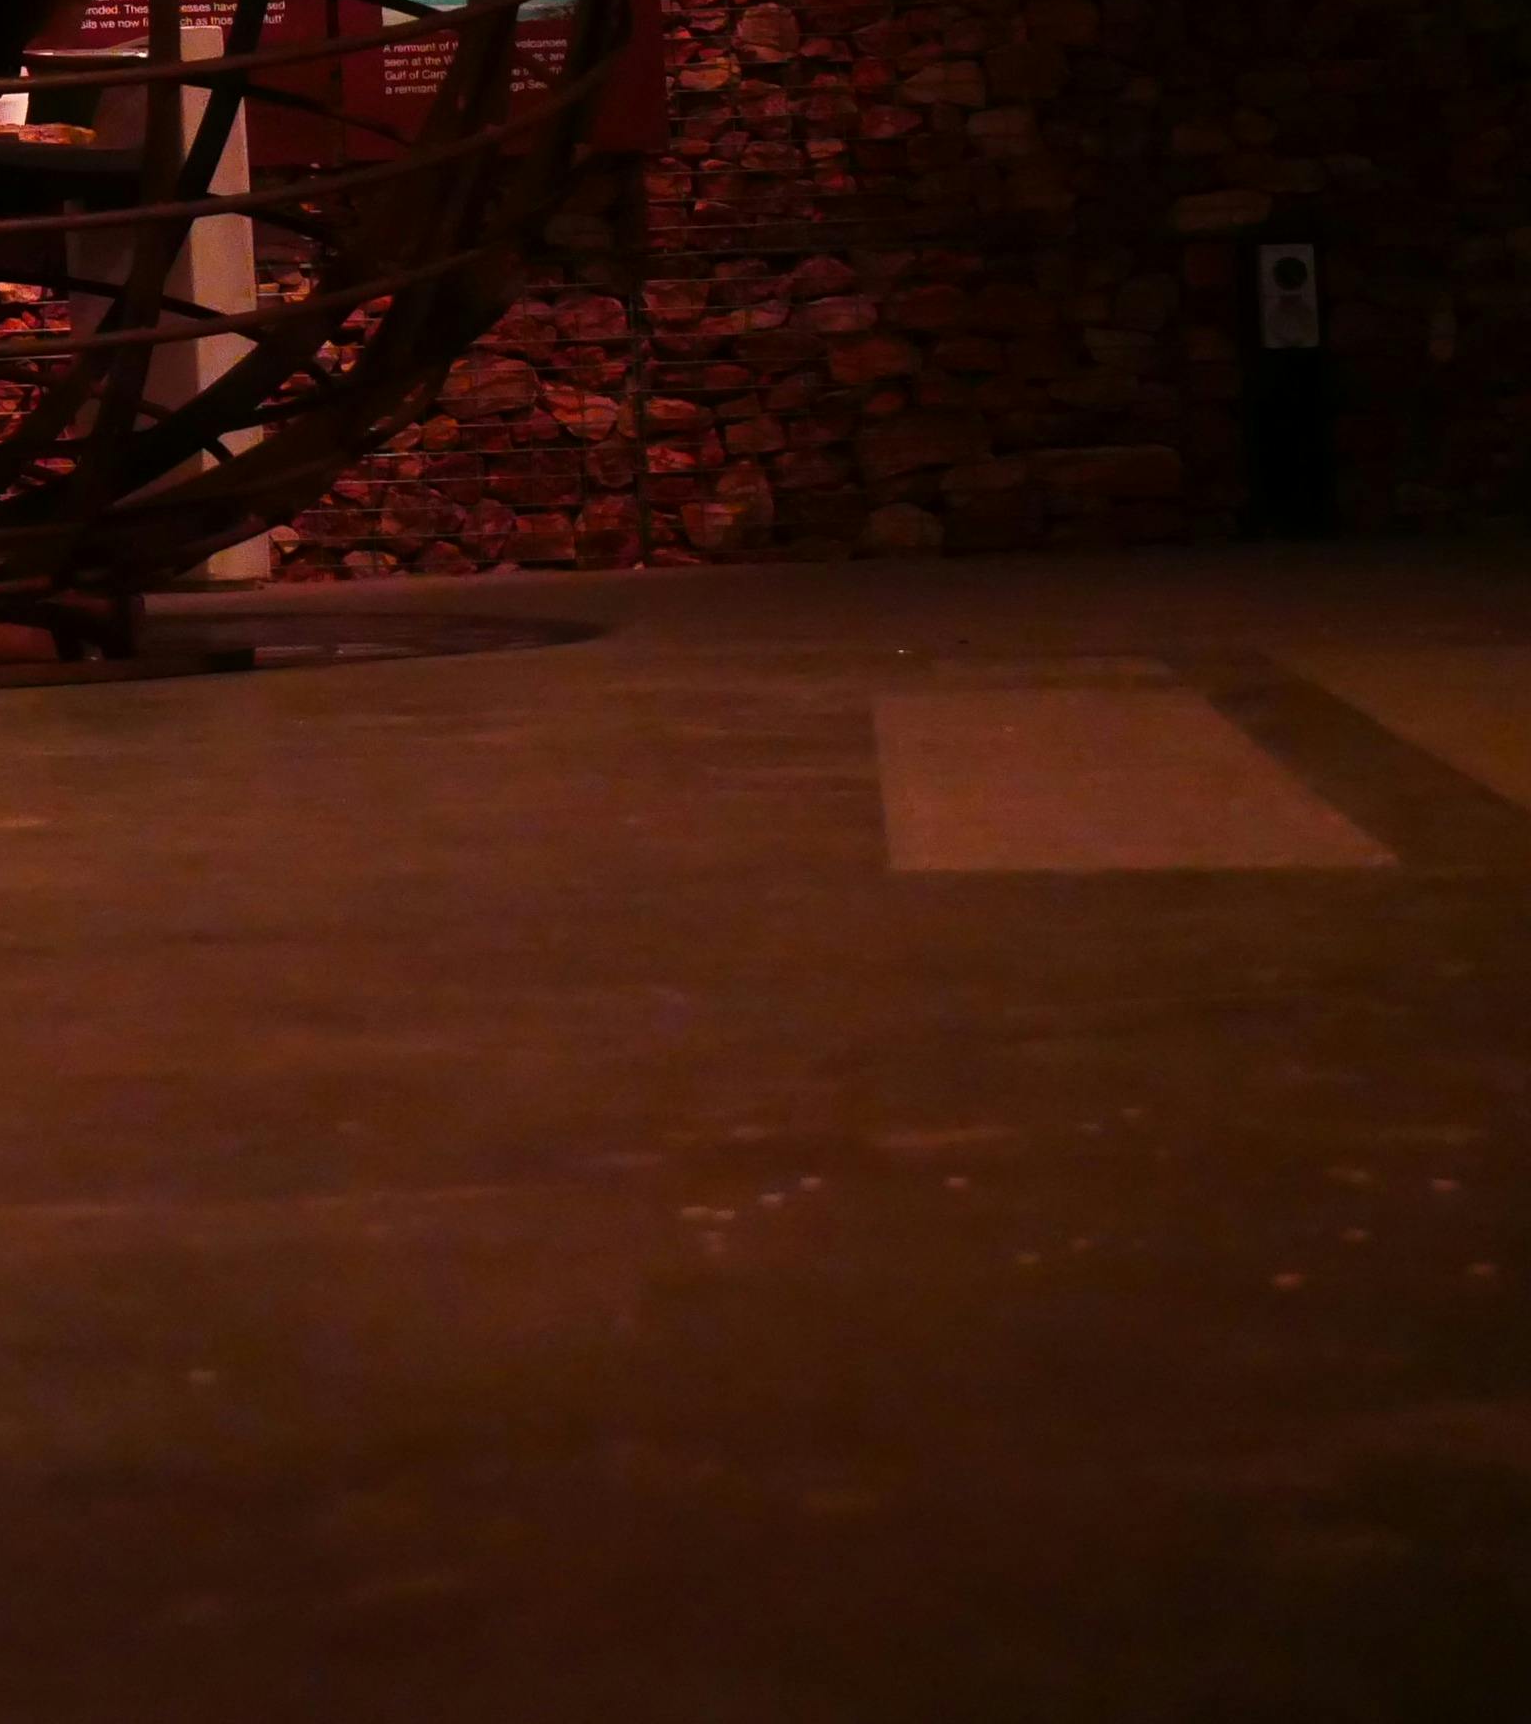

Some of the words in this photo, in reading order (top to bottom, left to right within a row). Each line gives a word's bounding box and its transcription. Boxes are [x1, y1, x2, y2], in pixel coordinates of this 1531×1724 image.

[213, 2, 238, 12] have
[99, 19, 116, 28] we
[117, 19, 140, 28] now
[195, 17, 209, 26] as
[393, 42, 436, 52] remnant
[439, 42, 450, 51] of
[515, 39, 568, 48] volcanoes
[384, 58, 409, 67] seen
[411, 57, 422, 66] at
[425, 56, 441, 66] the
[384, 70, 408, 81] Gulf
[409, 70, 420, 80] of
[395, 84, 437, 94] remnant
